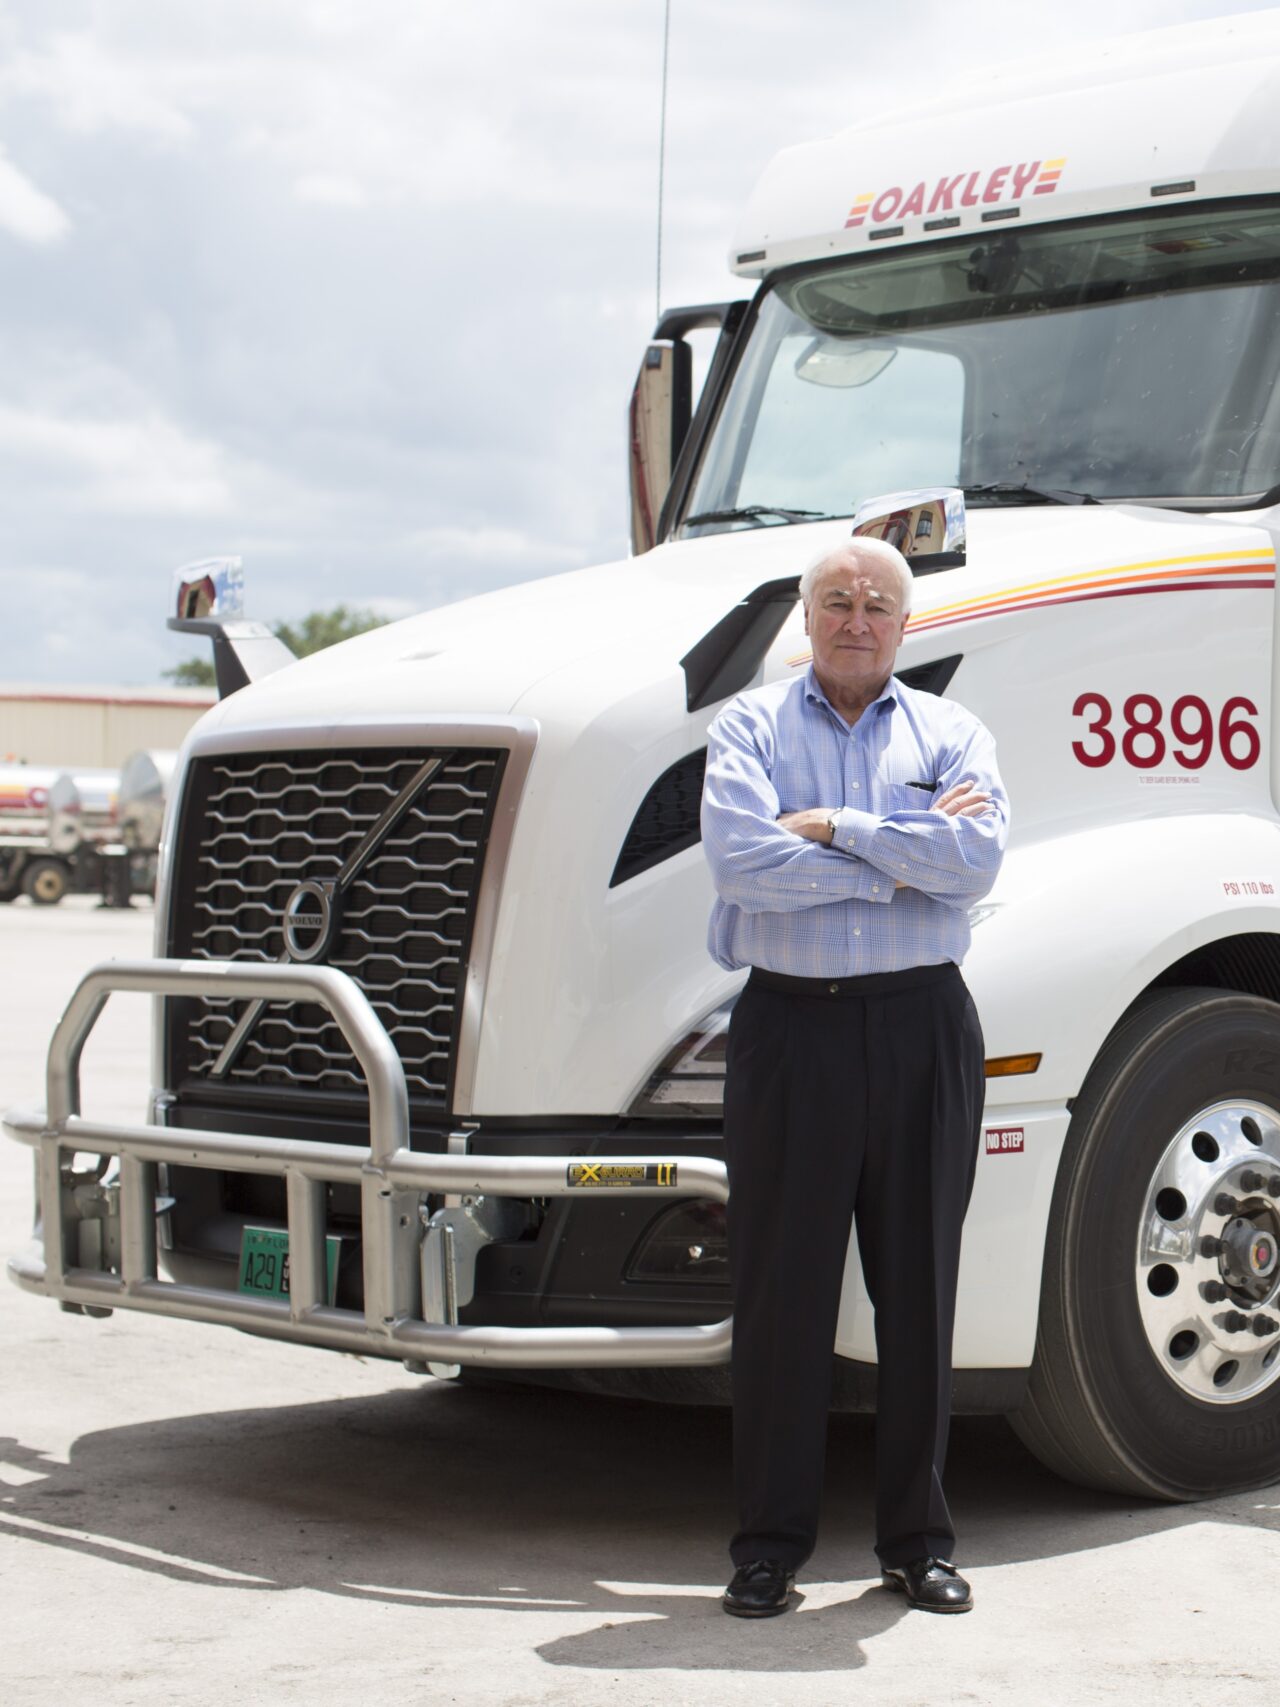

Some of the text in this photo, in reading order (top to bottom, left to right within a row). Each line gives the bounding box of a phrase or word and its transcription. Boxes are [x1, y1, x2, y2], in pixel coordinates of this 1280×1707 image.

[871, 161, 1041, 223] OAKLEY
[1071, 692, 1261, 770] 3896
[1223, 881, 1274, 896] PSI 110 lbs
[288, 915, 323, 925] VOLVO
[986, 1131, 1023, 1149] NO STEP
[657, 1163, 674, 1185] LT
[244, 1252, 276, 1290] A29
